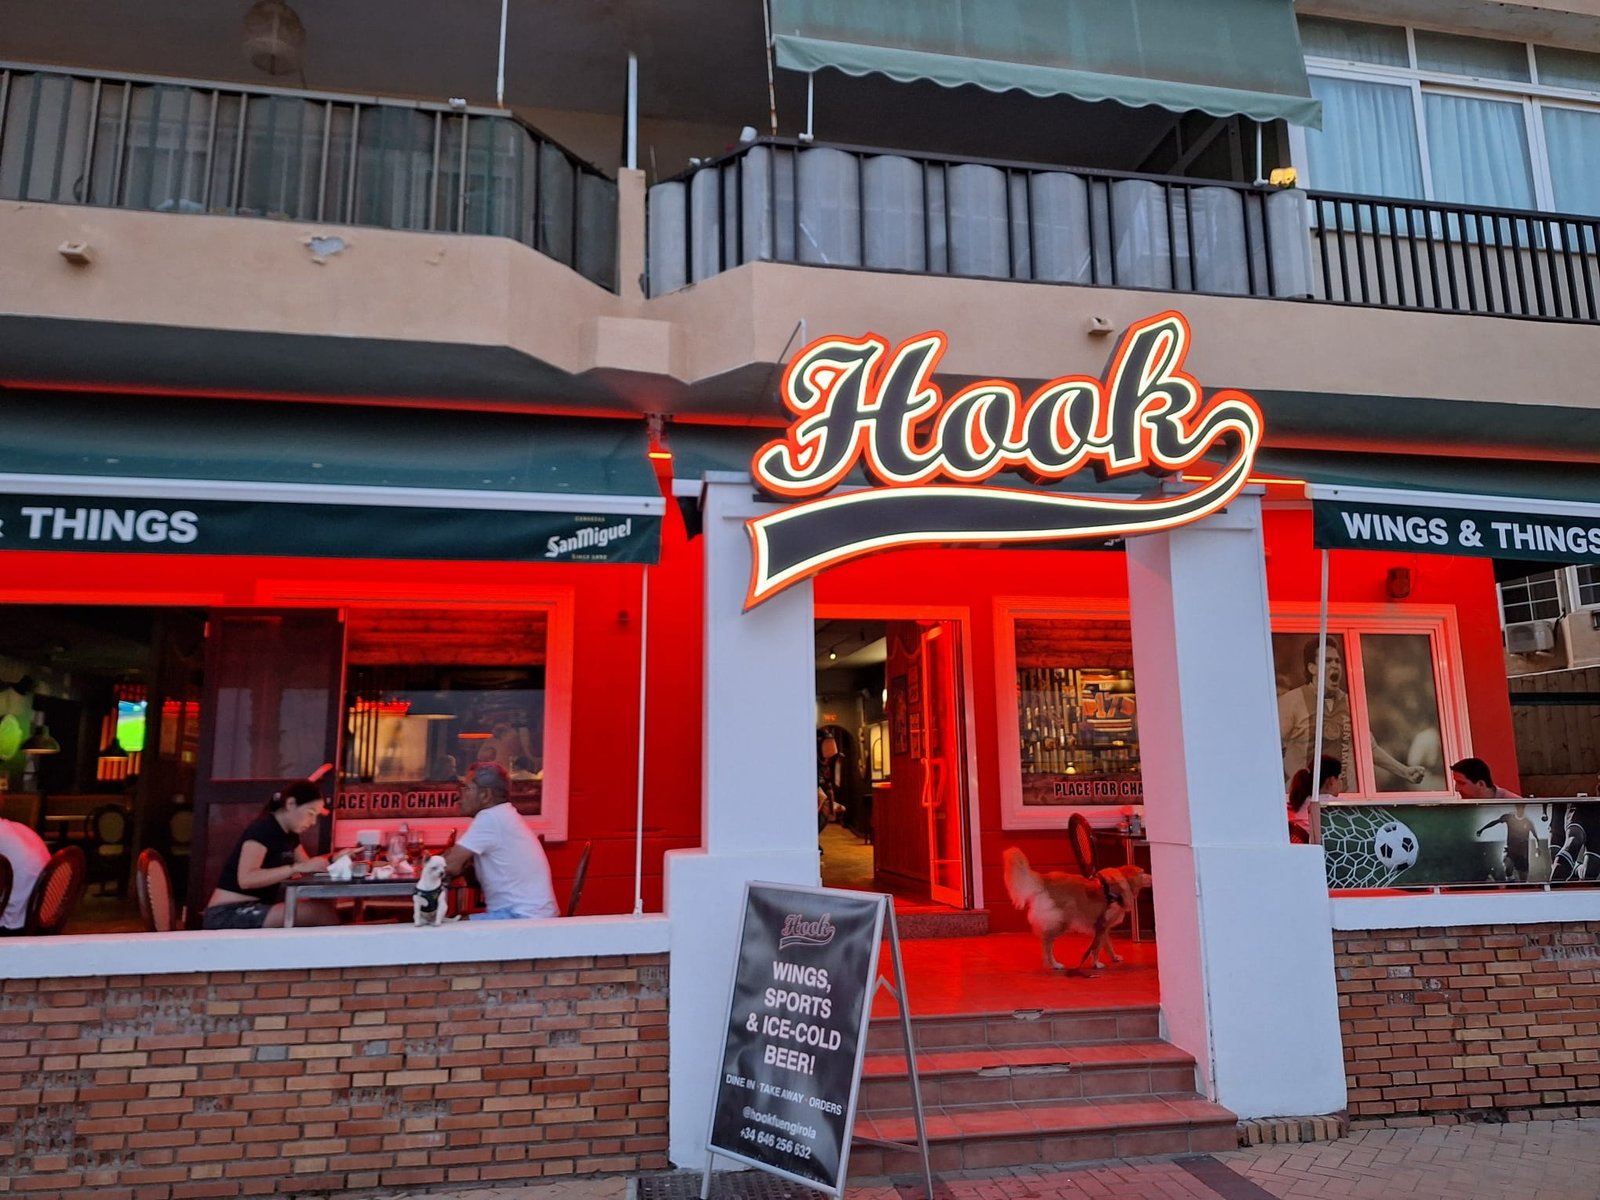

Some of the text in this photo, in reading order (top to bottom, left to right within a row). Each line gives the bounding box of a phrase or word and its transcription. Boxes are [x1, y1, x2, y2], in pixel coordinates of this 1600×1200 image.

[752, 310, 1264, 498] Hook
[21, 507, 199, 543] THINGS
[1341, 512, 1600, 554] WINGS & THINGS
[337, 792, 460, 809] ACE FOR CHAMP
[1055, 781, 1090, 796] PLACE
[1095, 781, 1117, 796] FOR
[780, 913, 836, 938] Hook
[773, 961, 832, 993] WINGS,
[764, 987, 832, 1019] SPORTS
[745, 1012, 842, 1050] & ICE-COLD
[764, 1044, 816, 1075] BEER!
[726, 1074, 842, 1115] DINE IN TAKE AWAY ORDERS
[742, 1106, 817, 1139] @hookfuengirola
[740, 1127, 812, 1160] +34 646 256 632
